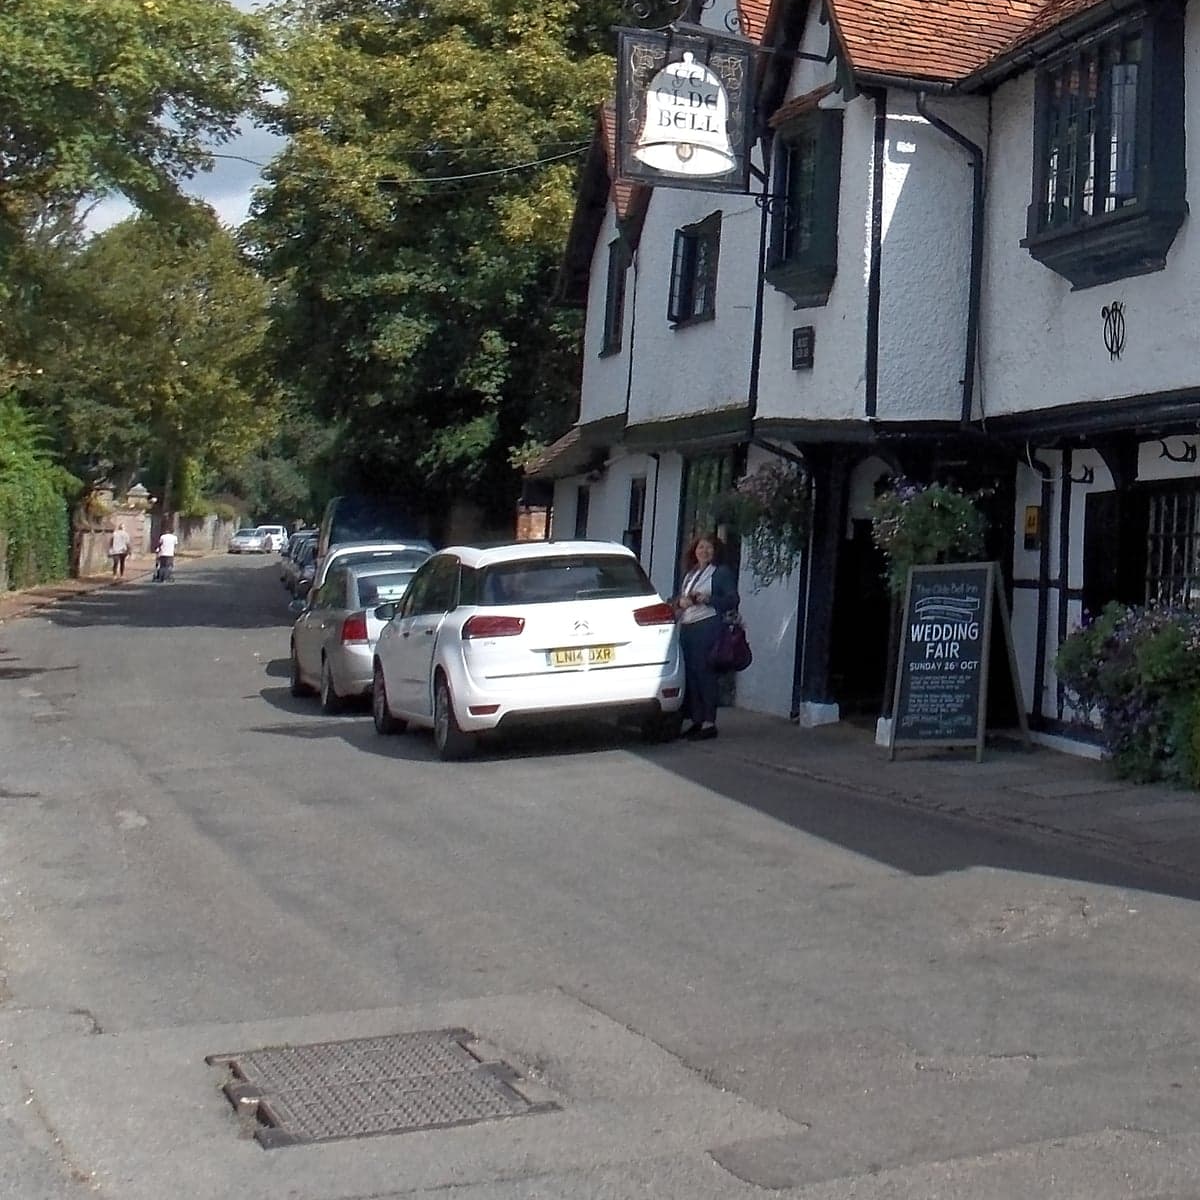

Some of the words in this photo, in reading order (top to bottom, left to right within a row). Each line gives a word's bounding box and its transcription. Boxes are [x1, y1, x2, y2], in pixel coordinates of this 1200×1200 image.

[655, 87, 718, 111] OLDE
[657, 109, 719, 133] BELL
[911, 622, 979, 642] WEDDING
[925, 641, 960, 659] FAIR
[909, 661, 943, 672] SUNDAY
[960, 661, 979, 670] OCT
